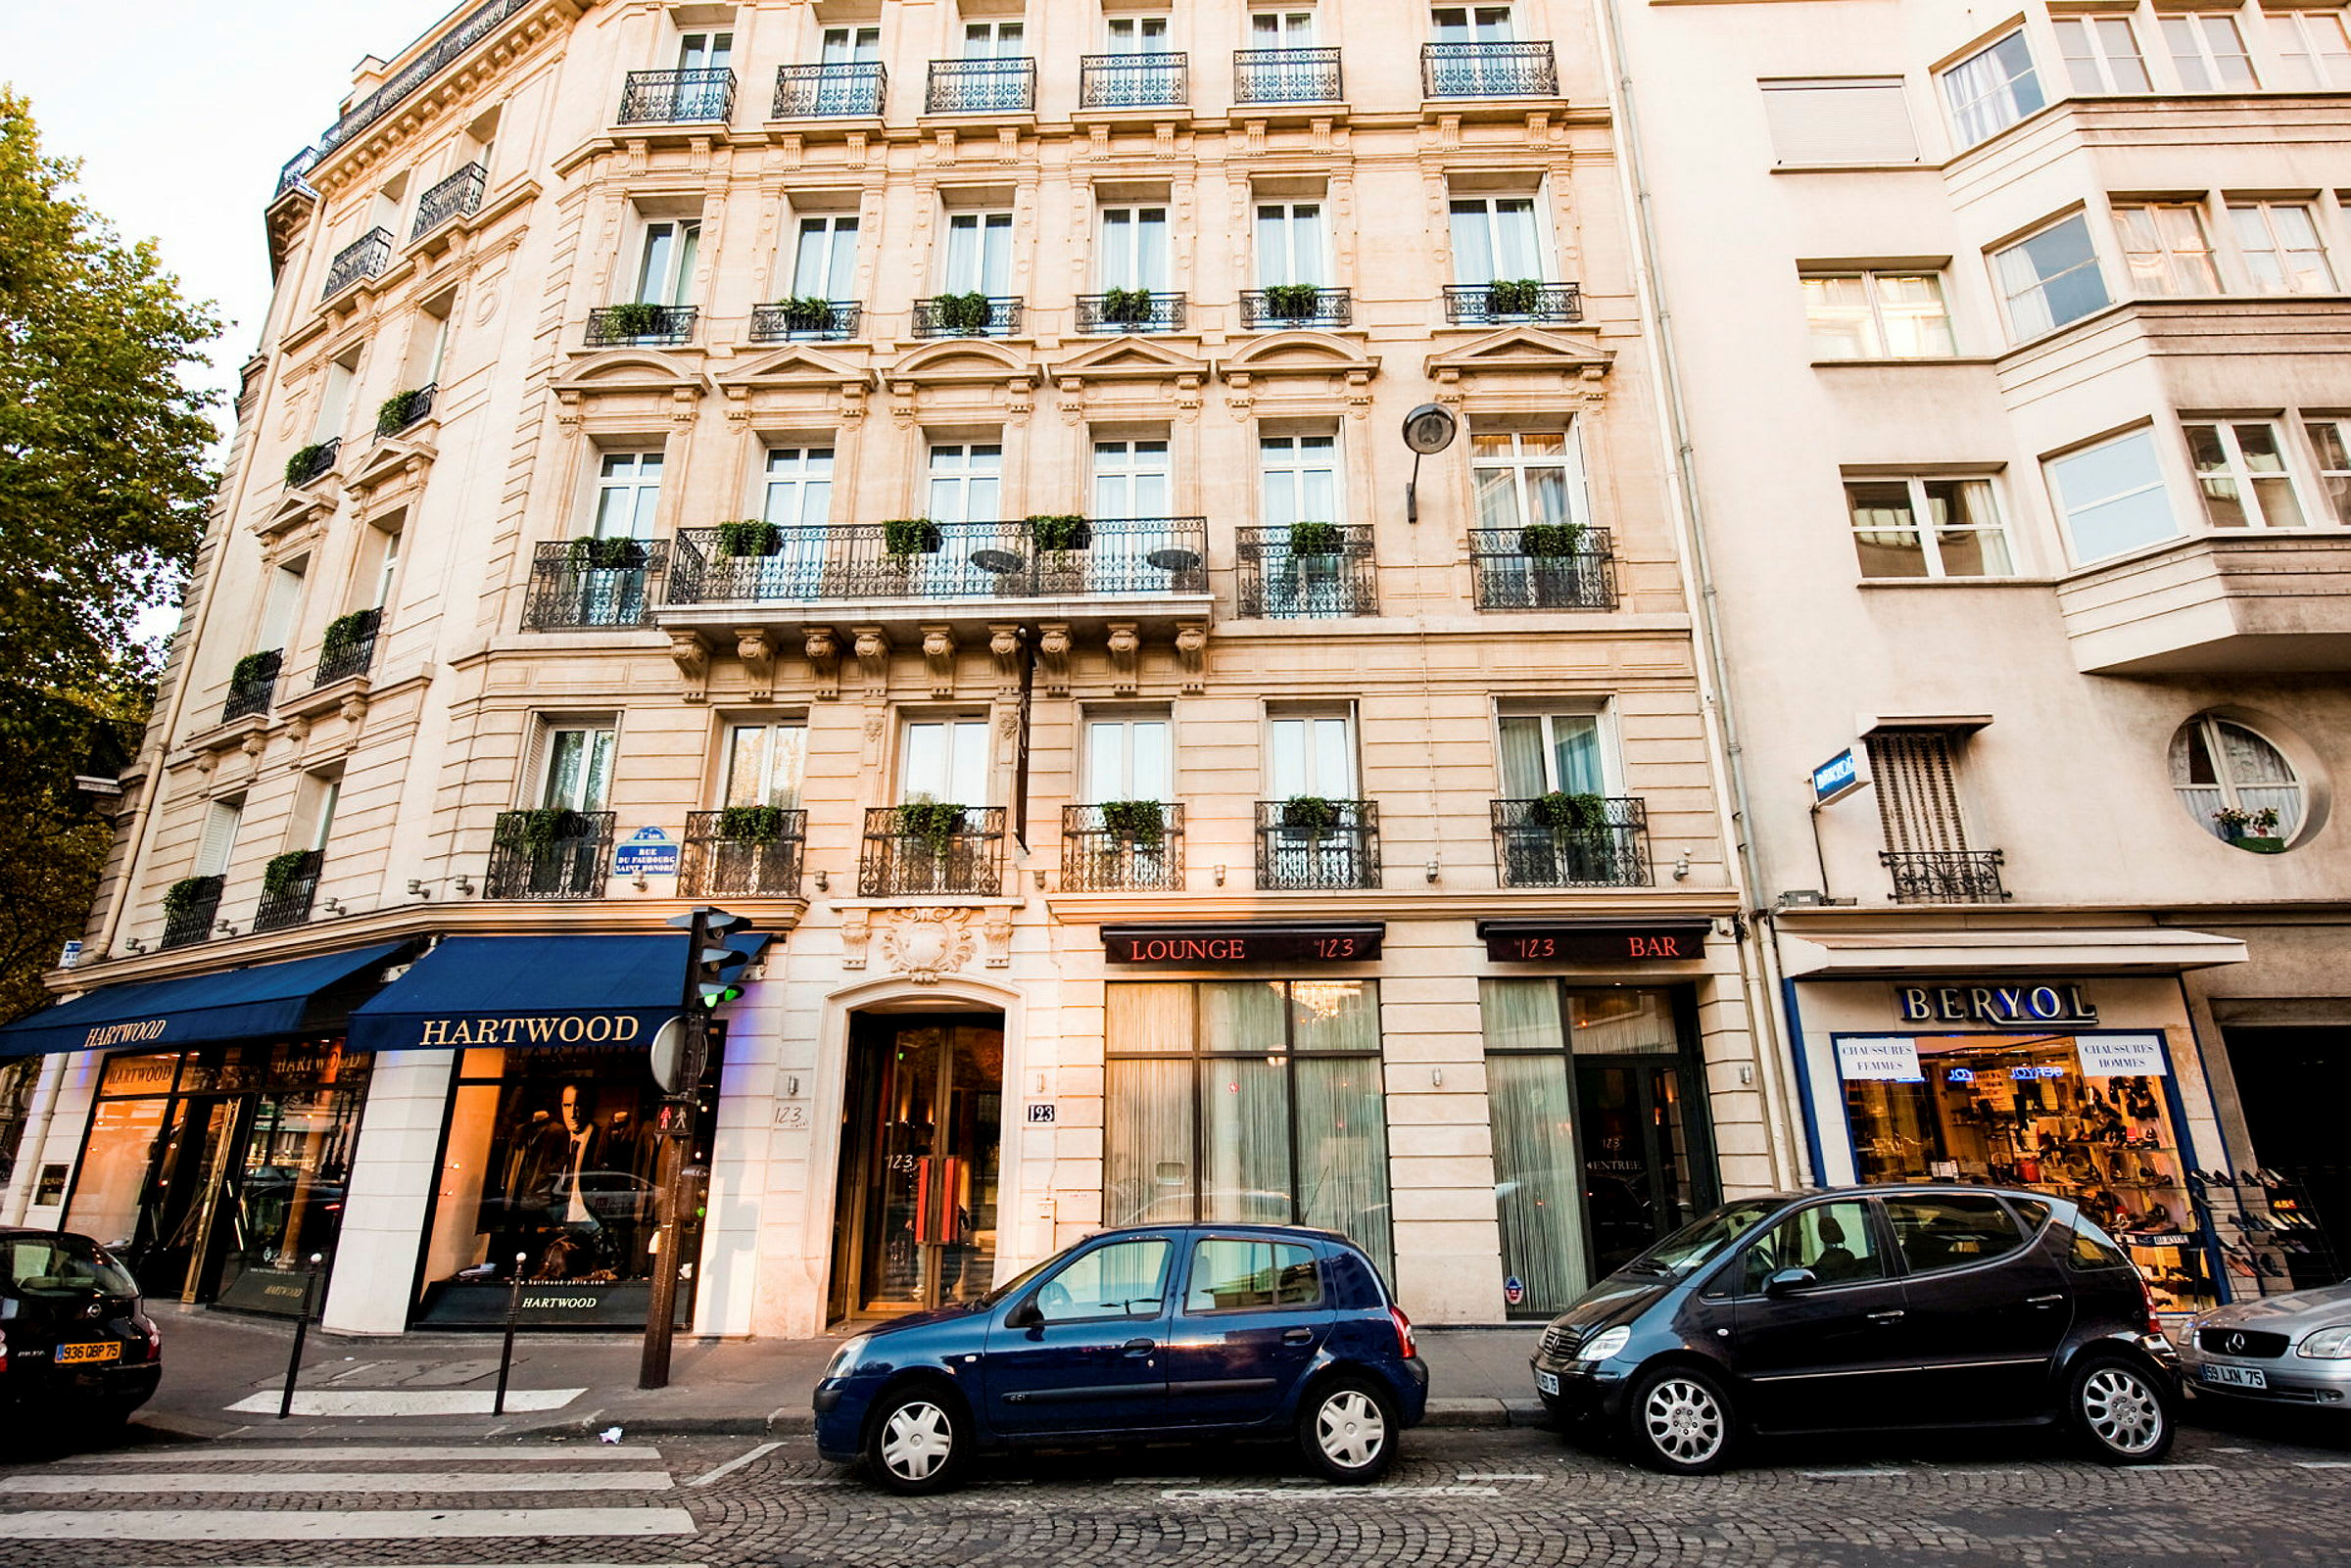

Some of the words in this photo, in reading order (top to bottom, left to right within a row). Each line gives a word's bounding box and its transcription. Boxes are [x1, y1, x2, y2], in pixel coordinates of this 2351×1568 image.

[1130, 939, 1245, 961] LOUNGE
[1628, 936, 1680, 957] BAR
[1900, 986, 2099, 1025] BERYOL
[84, 1020, 166, 1048] HARTWOOD
[419, 1016, 639, 1046] HARTWOOD
[1843, 1045, 1912, 1057] CHAUSSURES
[2085, 1043, 2154, 1055] CHAUSSURES
[1857, 1061, 1903, 1071] FEMMES
[2098, 1058, 2145, 1069] HOMMES
[109, 1065, 174, 1085] HARTWOOD
[775, 1106, 802, 1124] 123
[1030, 1105, 1053, 1121] 123
[888, 1154, 913, 1169] 123
[521, 1298, 597, 1308] HARTWOOD
[63, 1346, 83, 1359] 936
[106, 1343, 119, 1356] 75
[2221, 1367, 2242, 1383] LXN
[2245, 1370, 2263, 1386] 75
